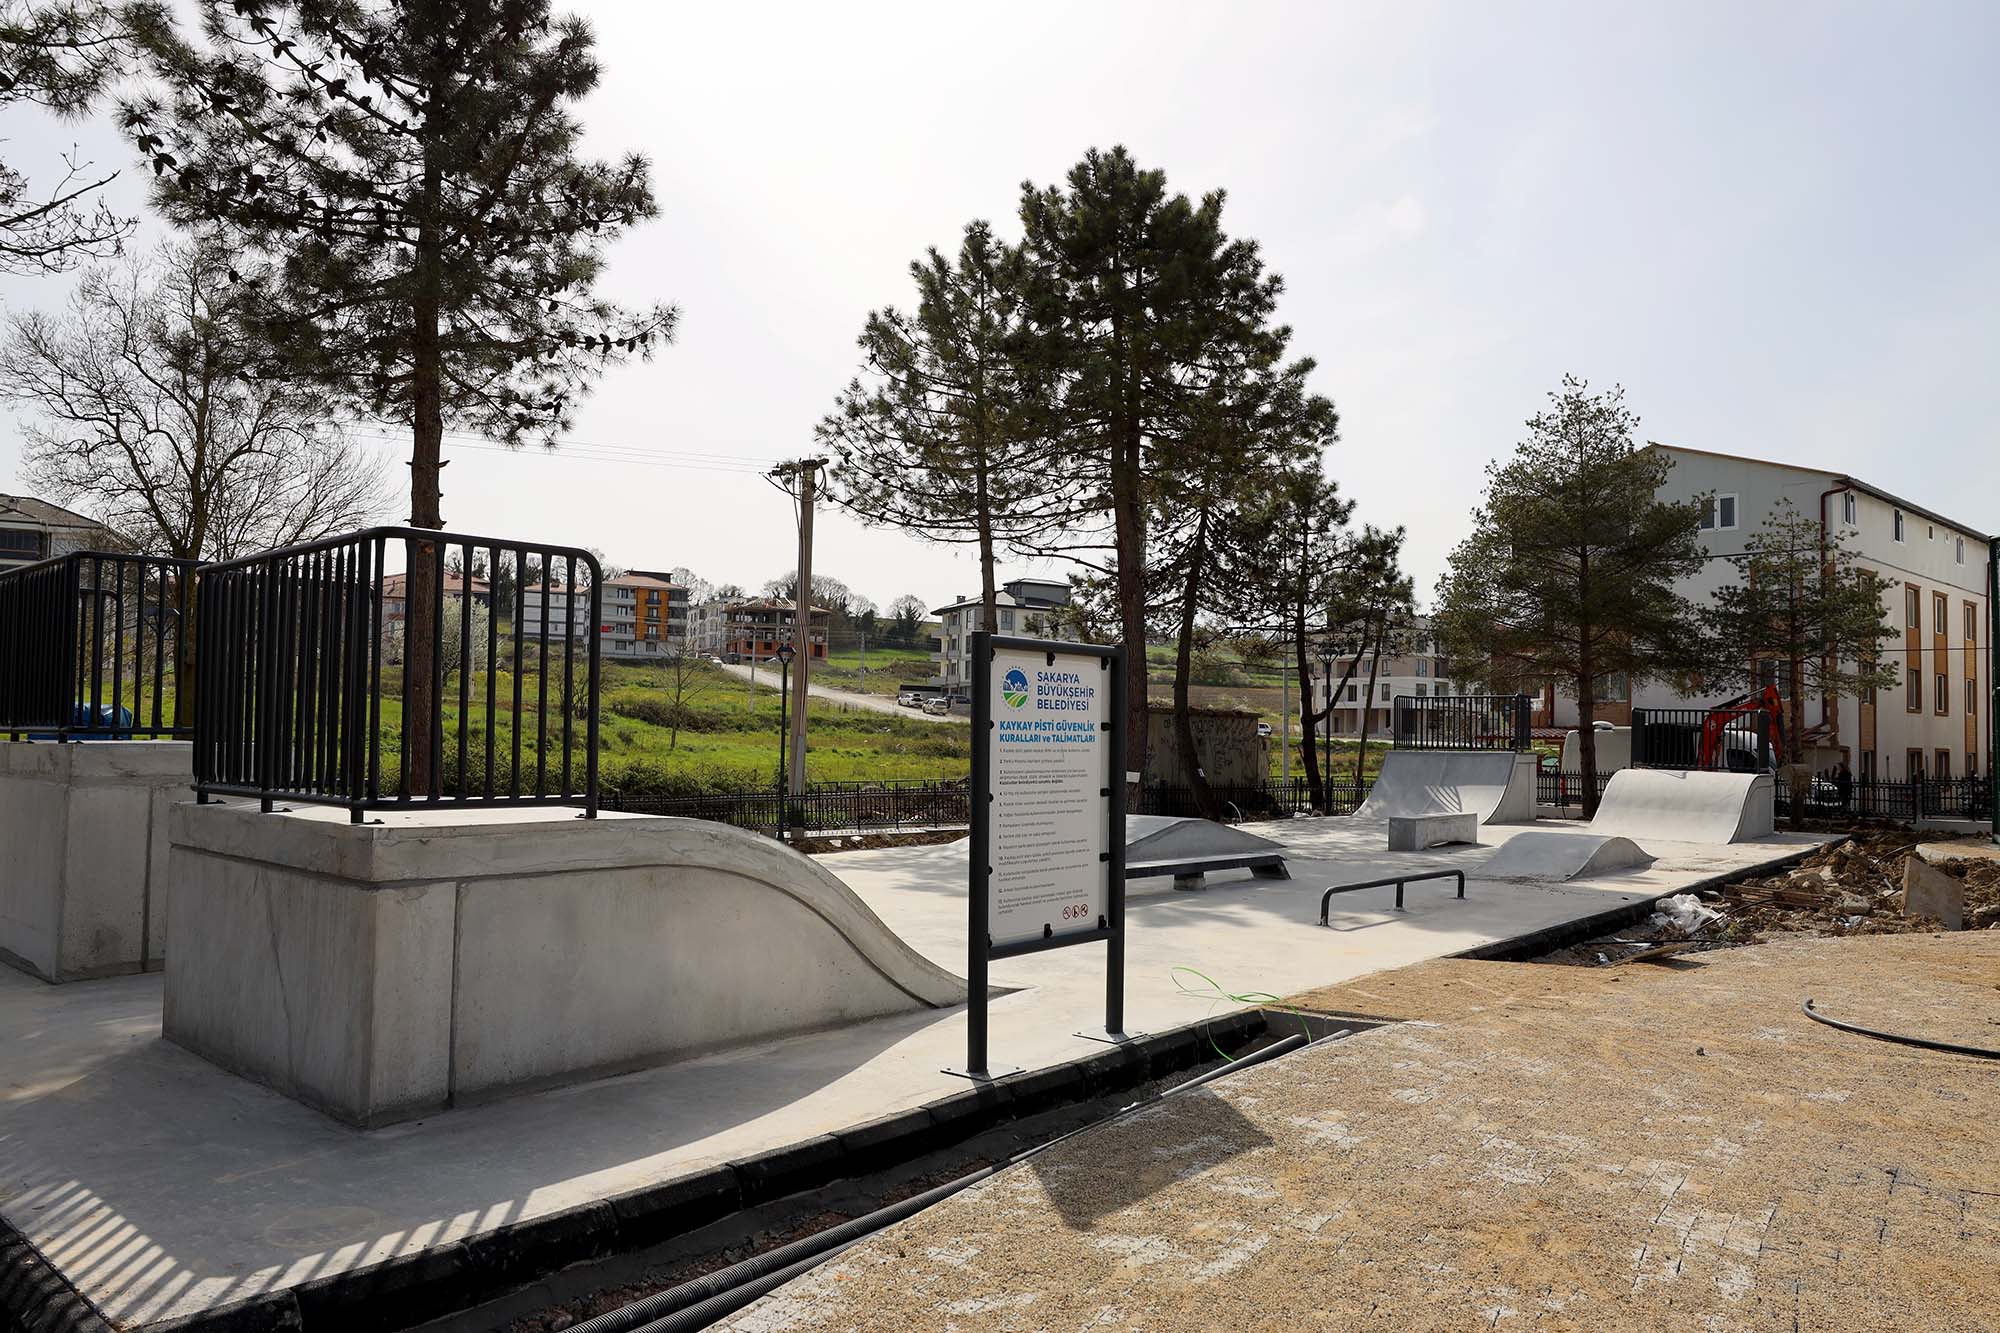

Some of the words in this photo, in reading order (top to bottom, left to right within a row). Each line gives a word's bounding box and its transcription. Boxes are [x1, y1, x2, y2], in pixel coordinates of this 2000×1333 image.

[1037, 671, 1080, 684] SAKARYA
[1037, 683, 1095, 698] BÜYÜKŞEHİR
[1037, 698, 1089, 711] BELEDİYESİ
[999, 720, 1033, 731] KAYKAY
[1034, 719, 1054, 731] PİSTİ
[1056, 720, 1095, 732] GÜVENLİK
[999, 733, 1041, 743] KURALLARI
[1042, 735, 1051, 743] ve
[1052, 732, 1096, 743] TALİMATLARI
